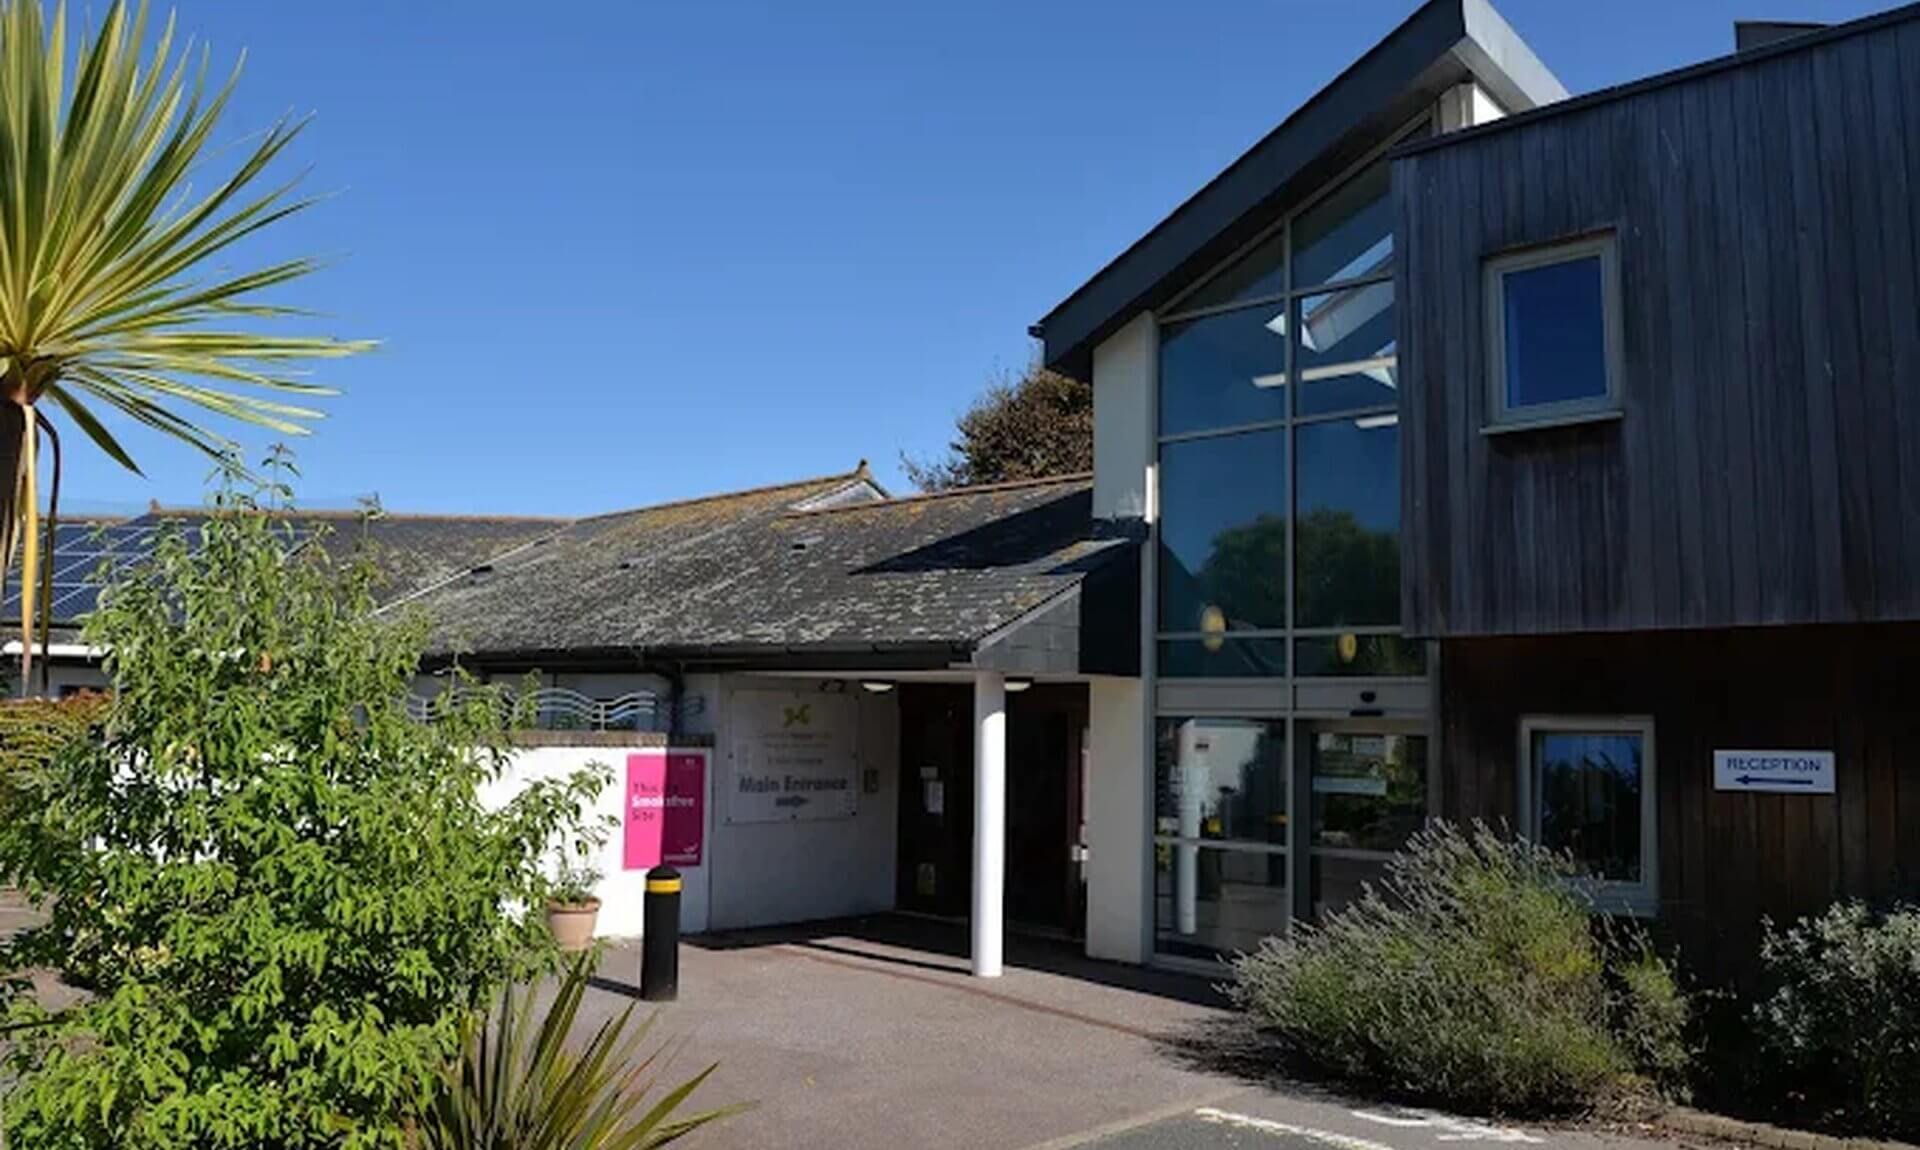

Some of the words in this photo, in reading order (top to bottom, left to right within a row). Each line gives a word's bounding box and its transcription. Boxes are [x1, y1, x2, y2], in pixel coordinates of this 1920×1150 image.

[1727, 757, 1821, 771] RECEPTION
[739, 776, 780, 792] Main
[784, 775, 848, 791] Entrance
[631, 795, 695, 808] Smokefree
